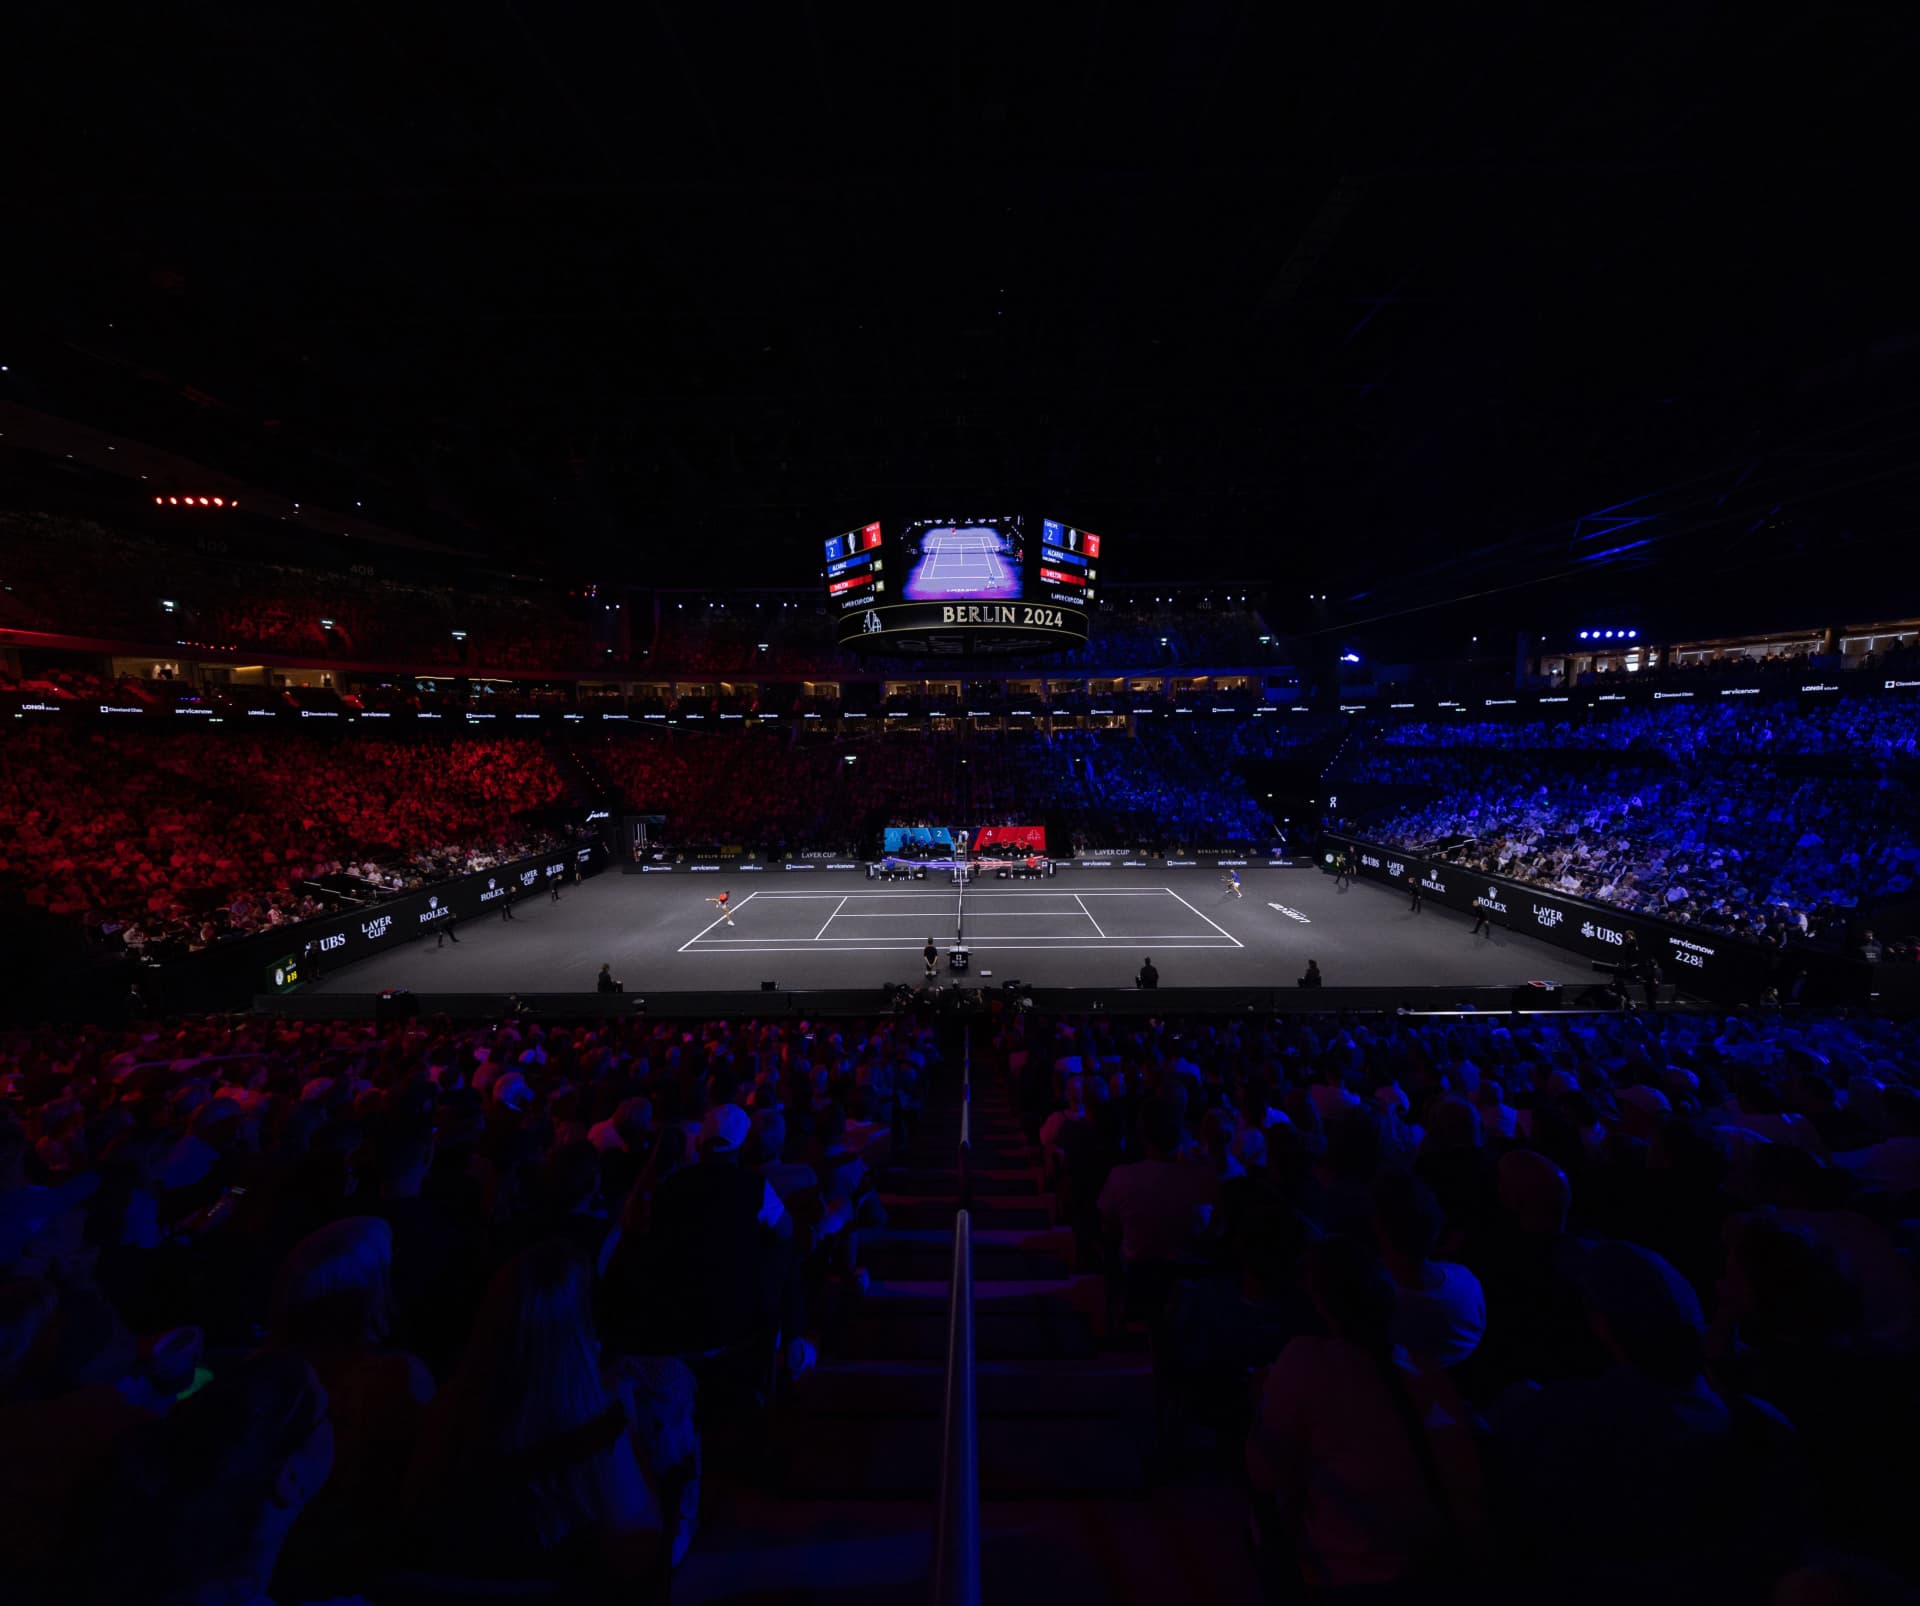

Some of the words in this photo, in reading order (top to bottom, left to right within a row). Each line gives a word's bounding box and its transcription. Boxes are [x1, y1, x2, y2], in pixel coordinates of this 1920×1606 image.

[1047, 530, 1053, 541] 2
[830, 547, 835, 558] 2
[1090, 543, 1096, 553] 4
[943, 606, 1016, 623] BERLIN
[1024, 608, 1063, 627] 2024
[936, 830, 942, 838] 2
[986, 829, 992, 837] 4
[1387, 860, 1404, 872] LAVER
[1390, 868, 1401, 877] CUP
[520, 869, 538, 881] LAVER
[1421, 878, 1445, 893] ROLEX
[480, 888, 504, 902] ROLEX
[1478, 896, 1507, 913] ROLEX
[420, 906, 449, 923] ROLEX
[1533, 904, 1563, 922] LAVER
[361, 915, 392, 933] LAVER
[1538, 916, 1556, 928] CUP
[368, 927, 386, 939] CUP
[1597, 926, 1623, 946] UBS
[320, 933, 346, 951] UBS
[1669, 937, 1715, 955] servicenow
[1675, 950, 1698, 966] 228
